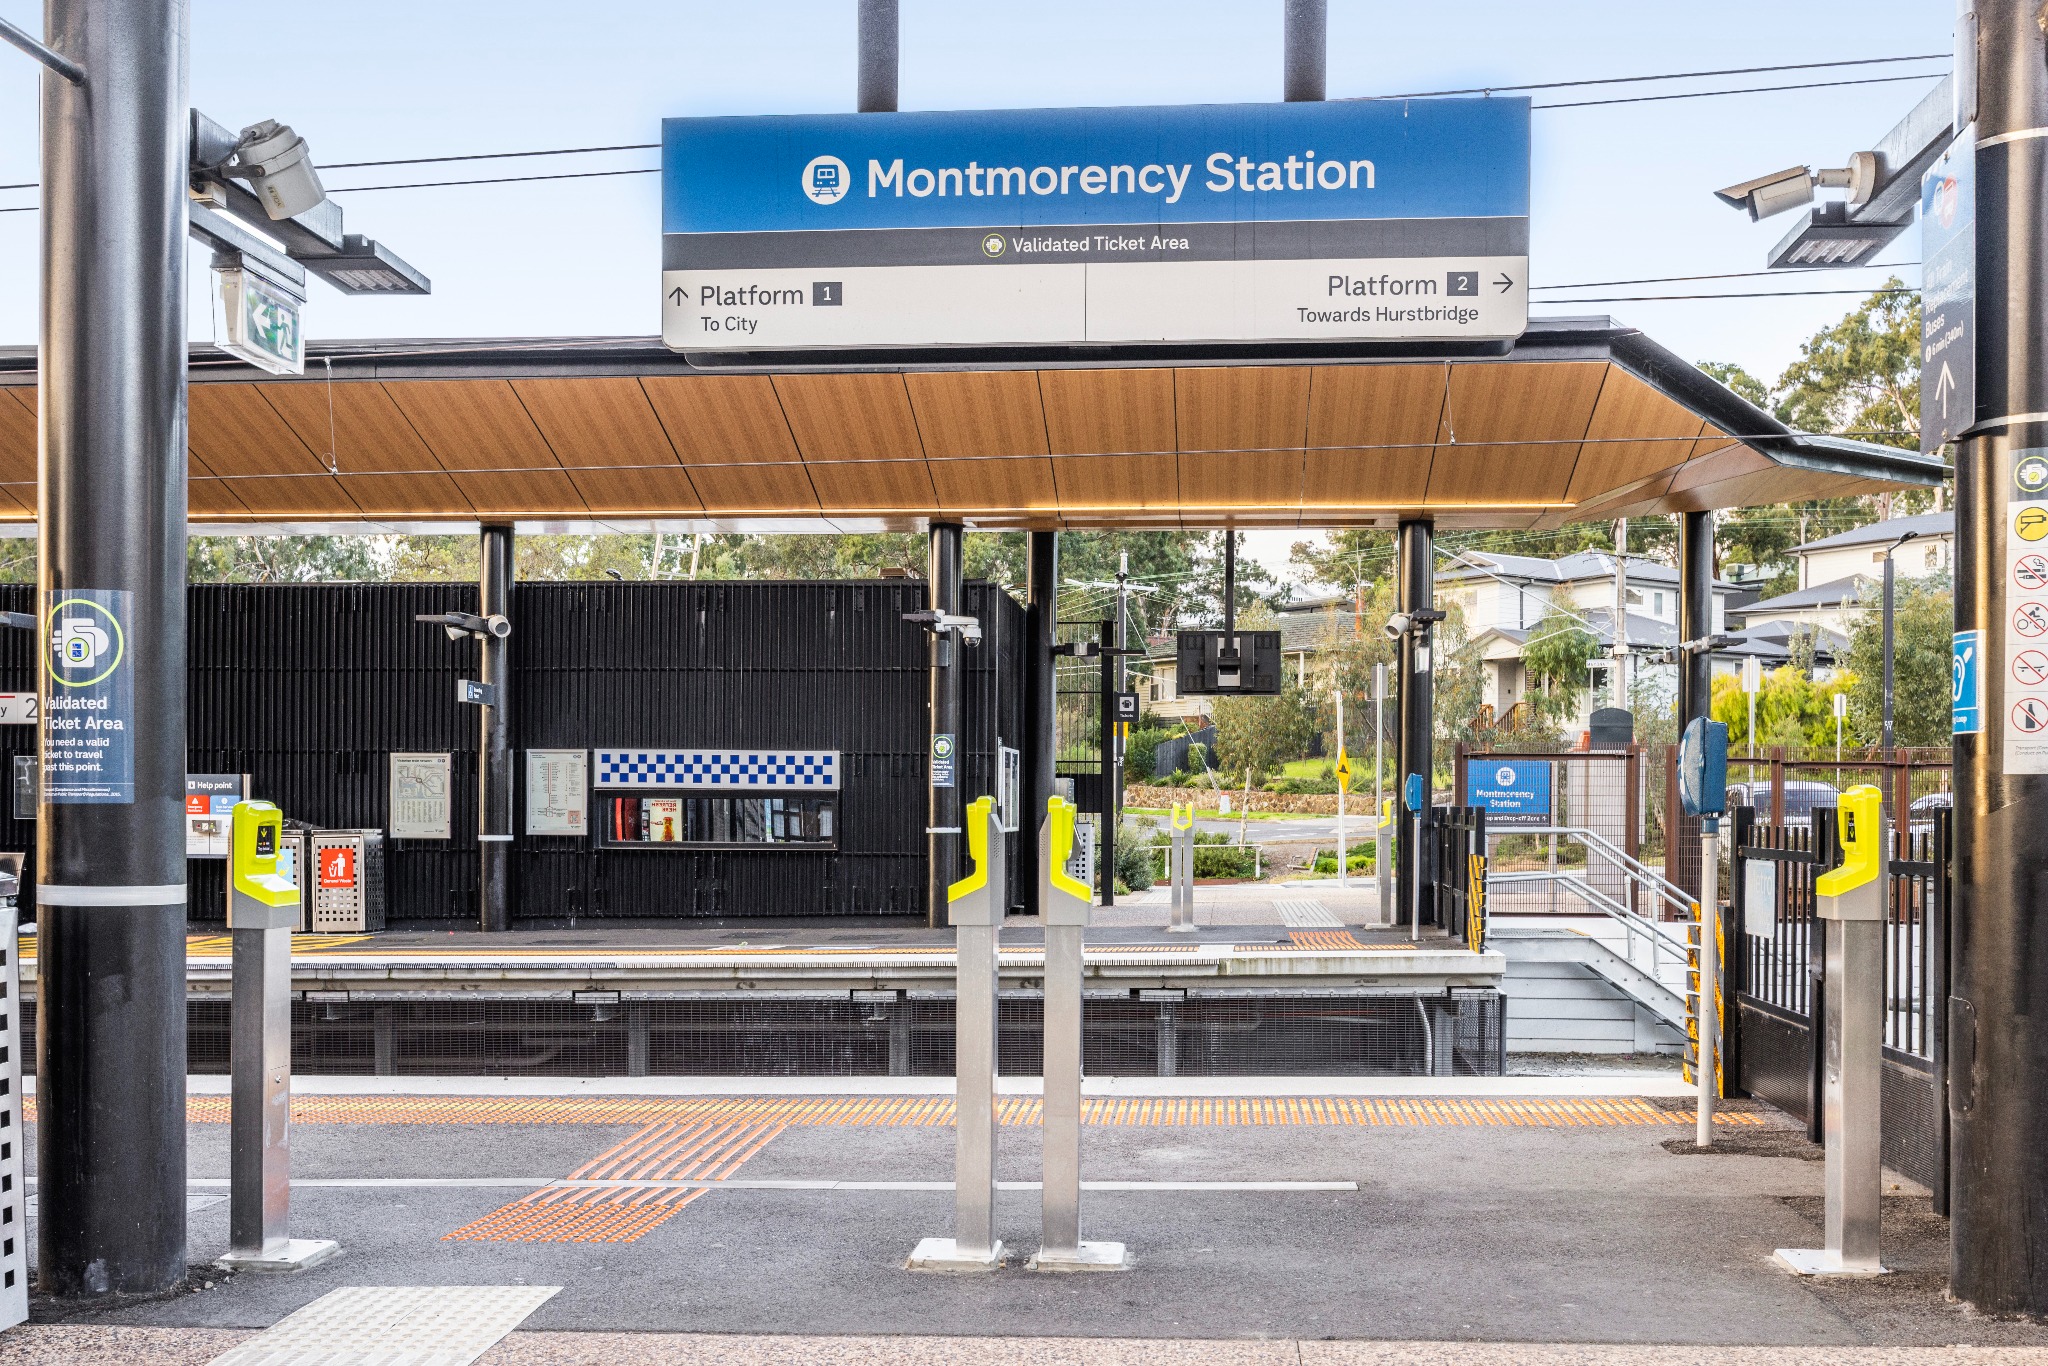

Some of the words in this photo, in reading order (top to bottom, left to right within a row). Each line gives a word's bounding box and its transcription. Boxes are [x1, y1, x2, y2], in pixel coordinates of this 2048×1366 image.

[867, 158, 1192, 204] Montmorency
[1205, 150, 1376, 194] Station
[1012, 236, 1090, 253] Validated
[1093, 235, 1146, 251] Ticket
[1150, 235, 1190, 250] Area
[1328, 274, 1437, 297] Platform
[1457, 276, 1469, 291] 2
[1926, 267, 1969, 316] Replacement
[700, 284, 804, 307] Platform
[822, 286, 832, 301] 1
[1297, 306, 1371, 323] Towards
[1376, 305, 1479, 325] Hurstbridge
[701, 316, 720, 332] To
[724, 316, 758, 335] City
[1926, 313, 1945, 339] Buses
[1945, 320, 1964, 349] (340m)
[25, 697, 38, 719] 2
[44, 695, 108, 710] Validated
[0, 706, 7, 718] y
[44, 715, 81, 730] Ticket
[84, 715, 124, 731] Area
[55, 737, 76, 747] need
[77, 739, 84, 747] a
[85, 737, 110, 747] valid
[44, 749, 63, 759] icket
[63, 750, 73, 759] to
[74, 749, 104, 759] travel
[58, 762, 74, 772] this
[75, 762, 104, 774] point.
[197, 781, 214, 791] Help
[214, 781, 233, 791] point
[1476, 790, 1534, 800] Montmorency
[1490, 799, 1520, 808] Station
